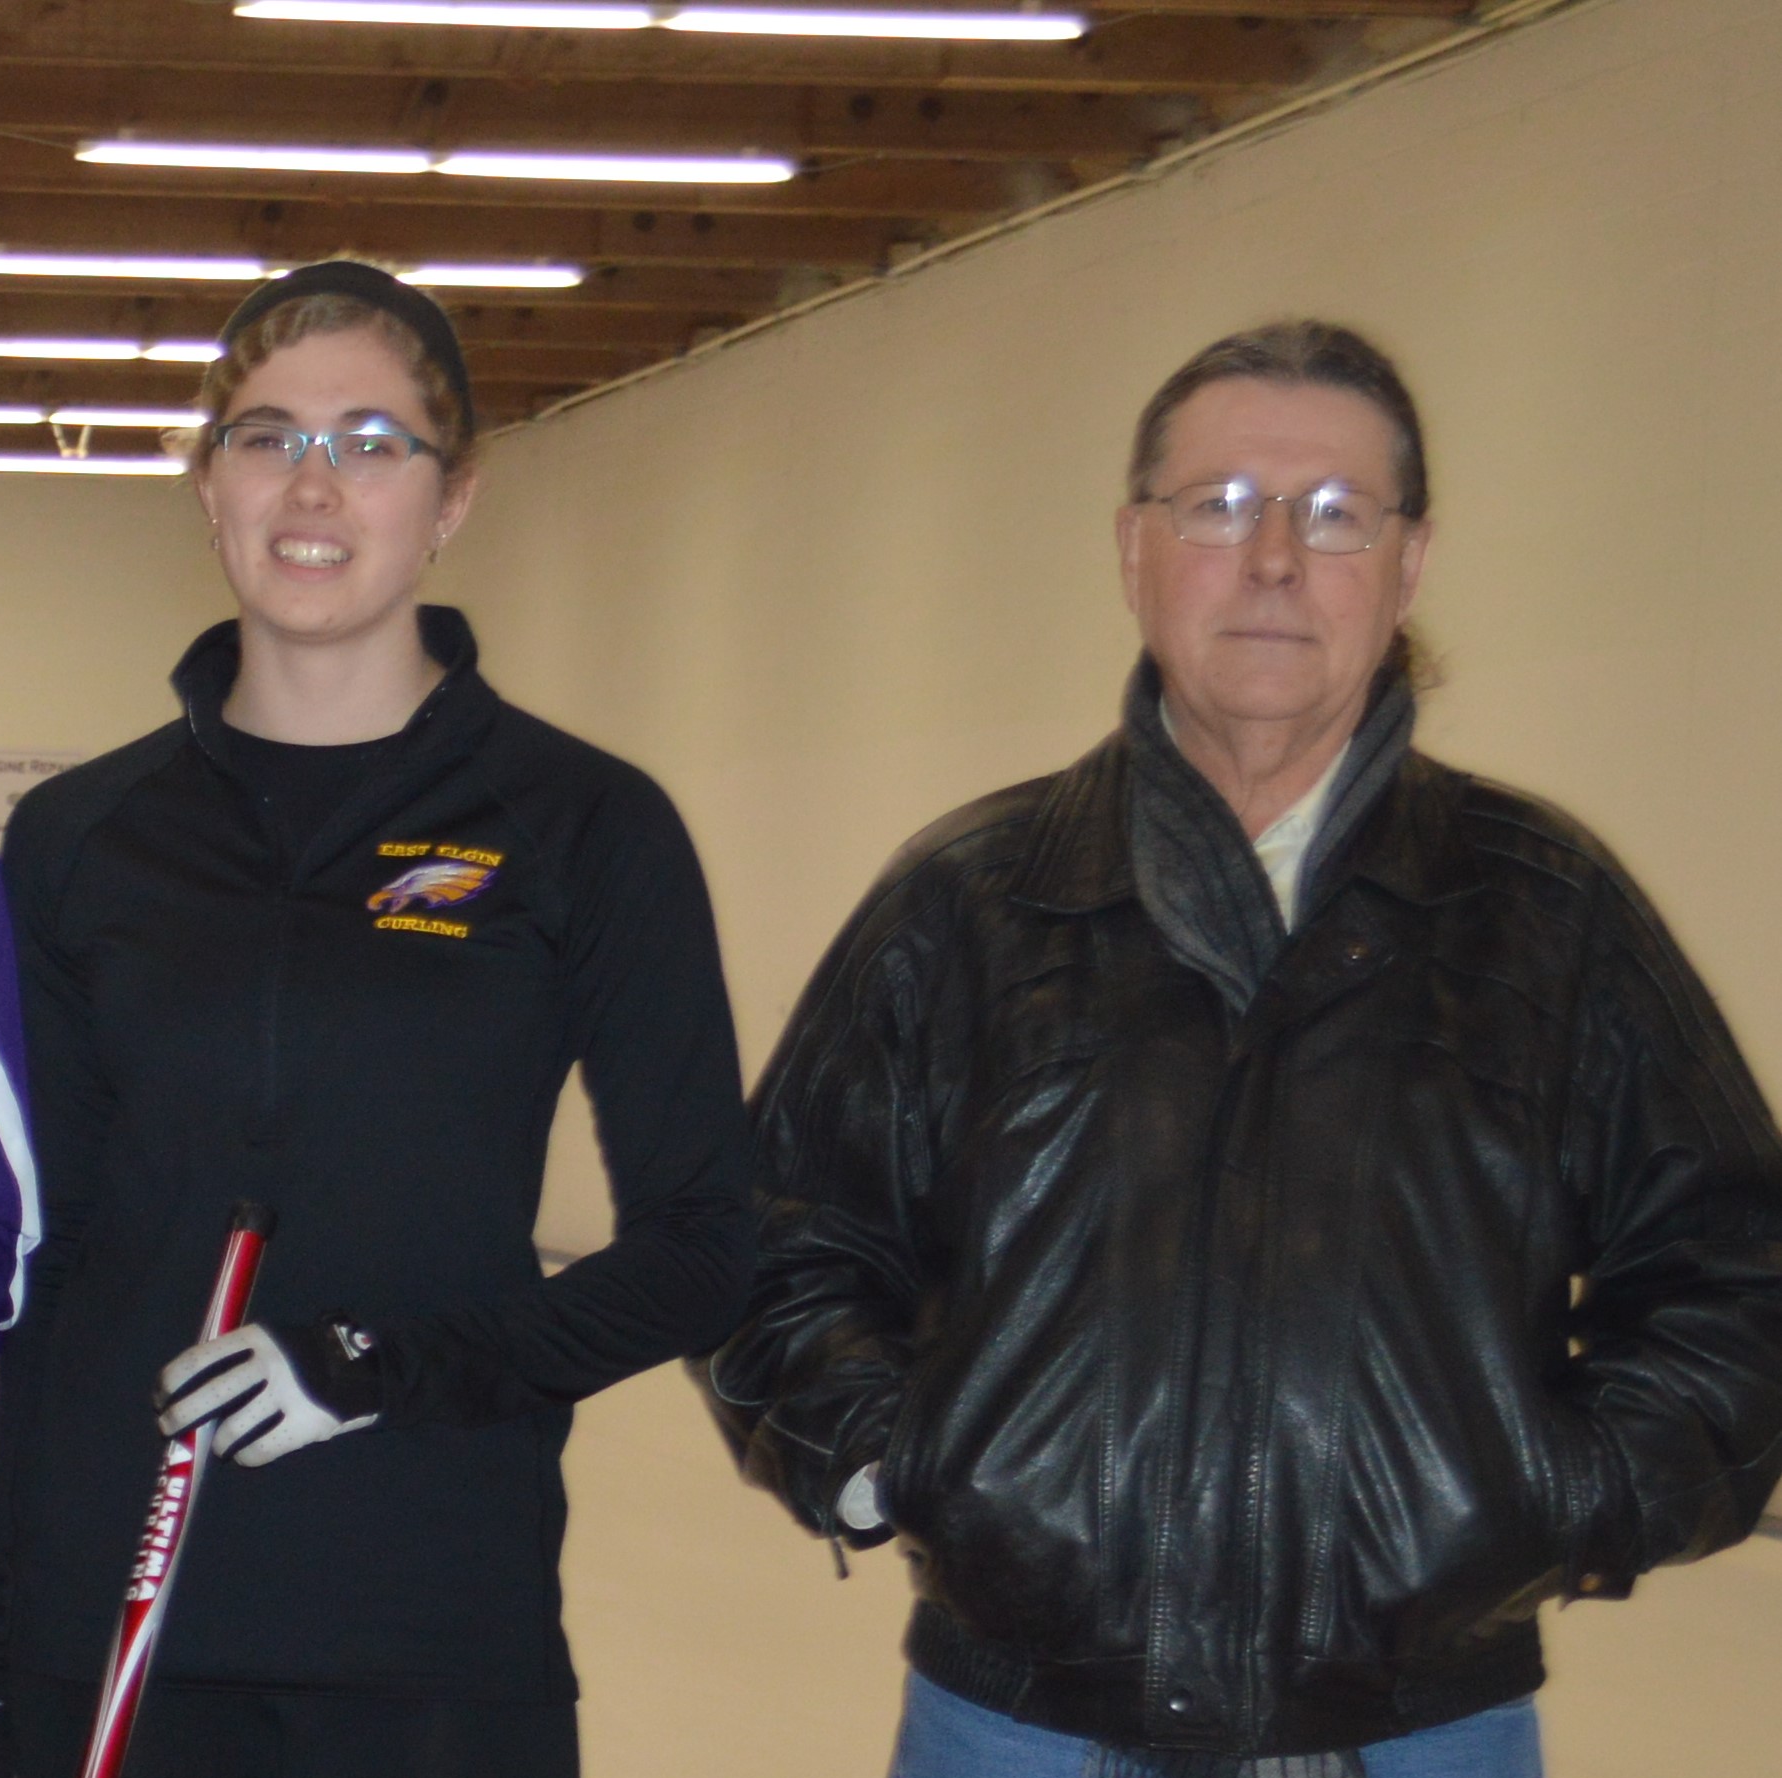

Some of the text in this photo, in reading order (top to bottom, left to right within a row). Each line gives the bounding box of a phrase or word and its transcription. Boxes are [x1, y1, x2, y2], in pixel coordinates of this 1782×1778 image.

[378, 843, 503, 868] EAST ELGIN
[374, 915, 469, 938] CURLING
[138, 1476, 186, 1602] ULTIMA
